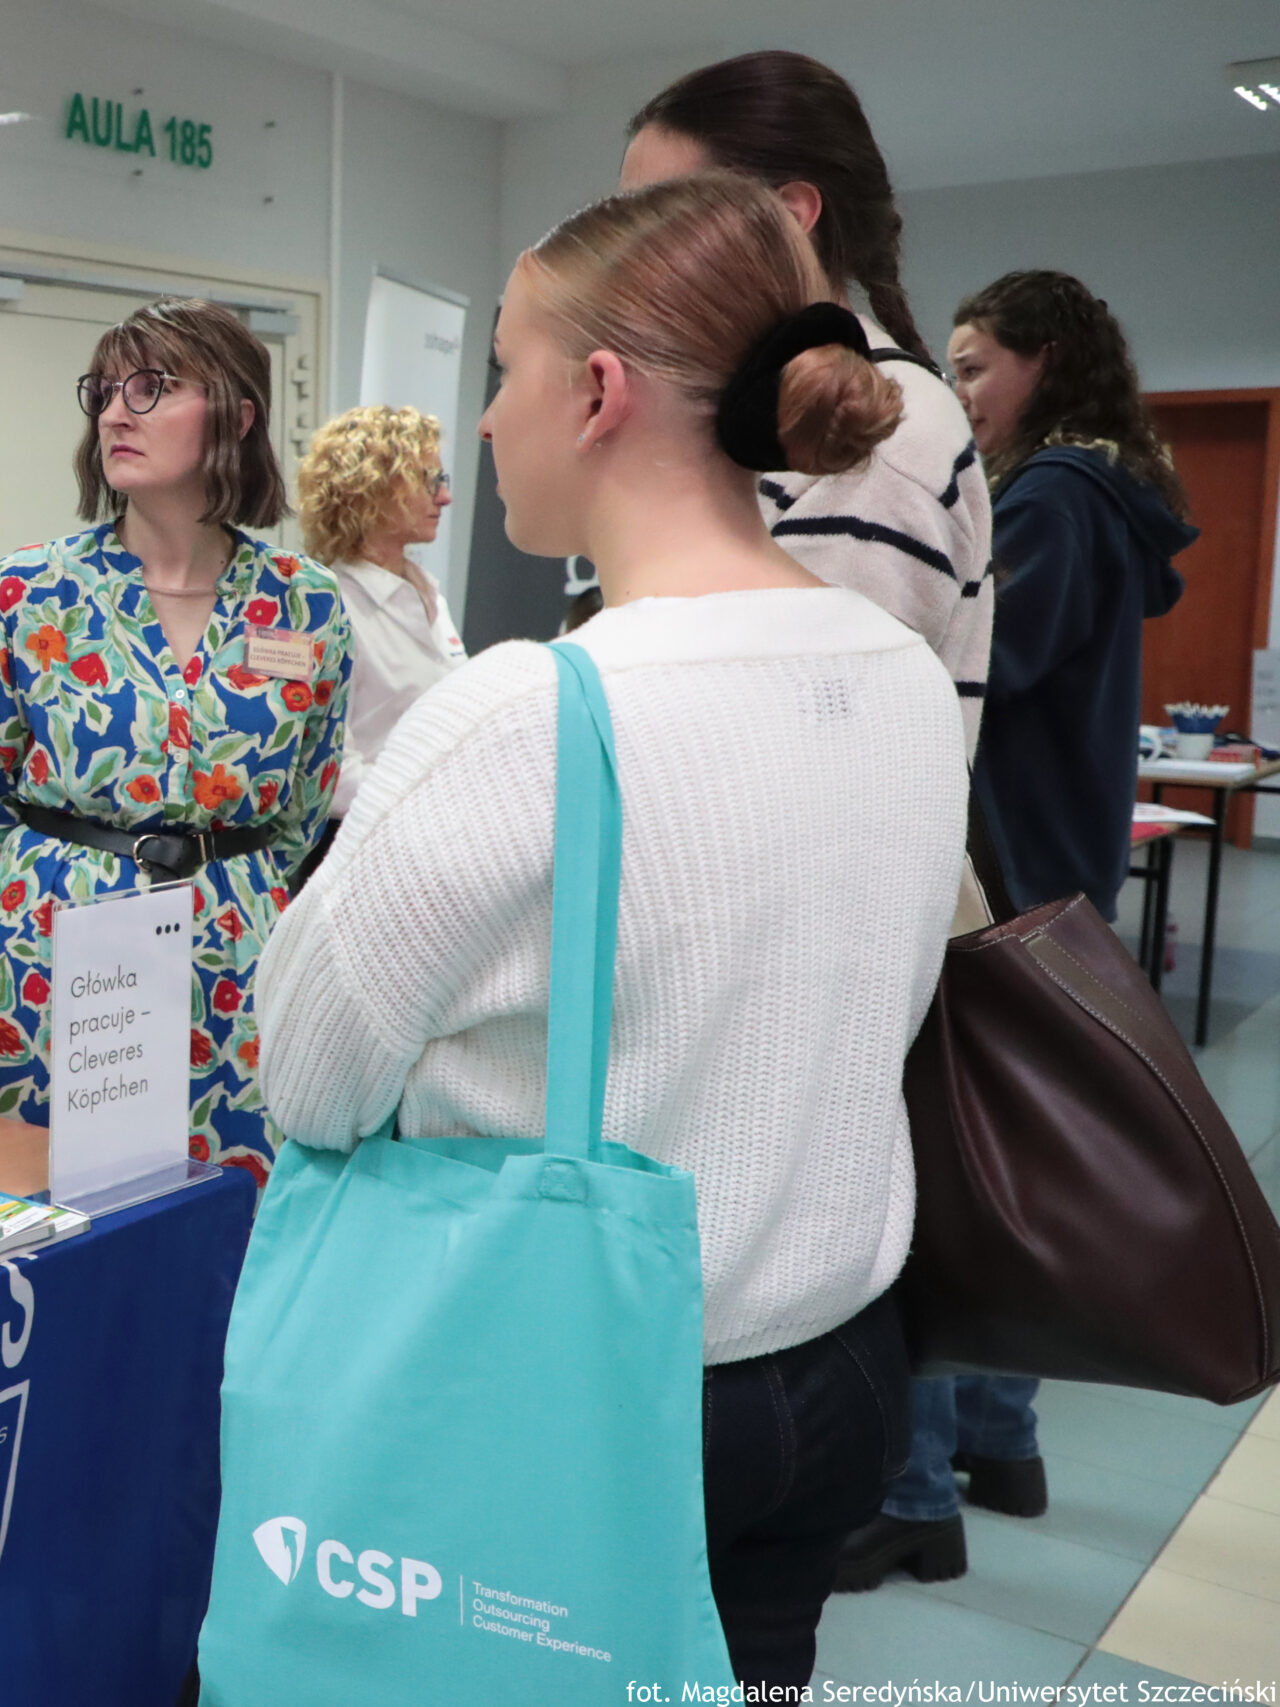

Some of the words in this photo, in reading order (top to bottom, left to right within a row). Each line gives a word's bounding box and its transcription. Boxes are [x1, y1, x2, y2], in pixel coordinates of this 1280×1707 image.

[66, 92, 157, 158] AULA
[165, 116, 213, 169] 185
[70, 965, 138, 999] Główka
[69, 1007, 135, 1045] pracuje
[68, 1043, 144, 1074] Cleveres
[67, 1074, 149, 1113] Köpfchen
[317, 1540, 442, 1617] CSP
[473, 1582, 568, 1617] Transformation
[473, 1599, 550, 1633] Outsourcing
[473, 1615, 533, 1644] Customer
[536, 1633, 612, 1663] Experience
